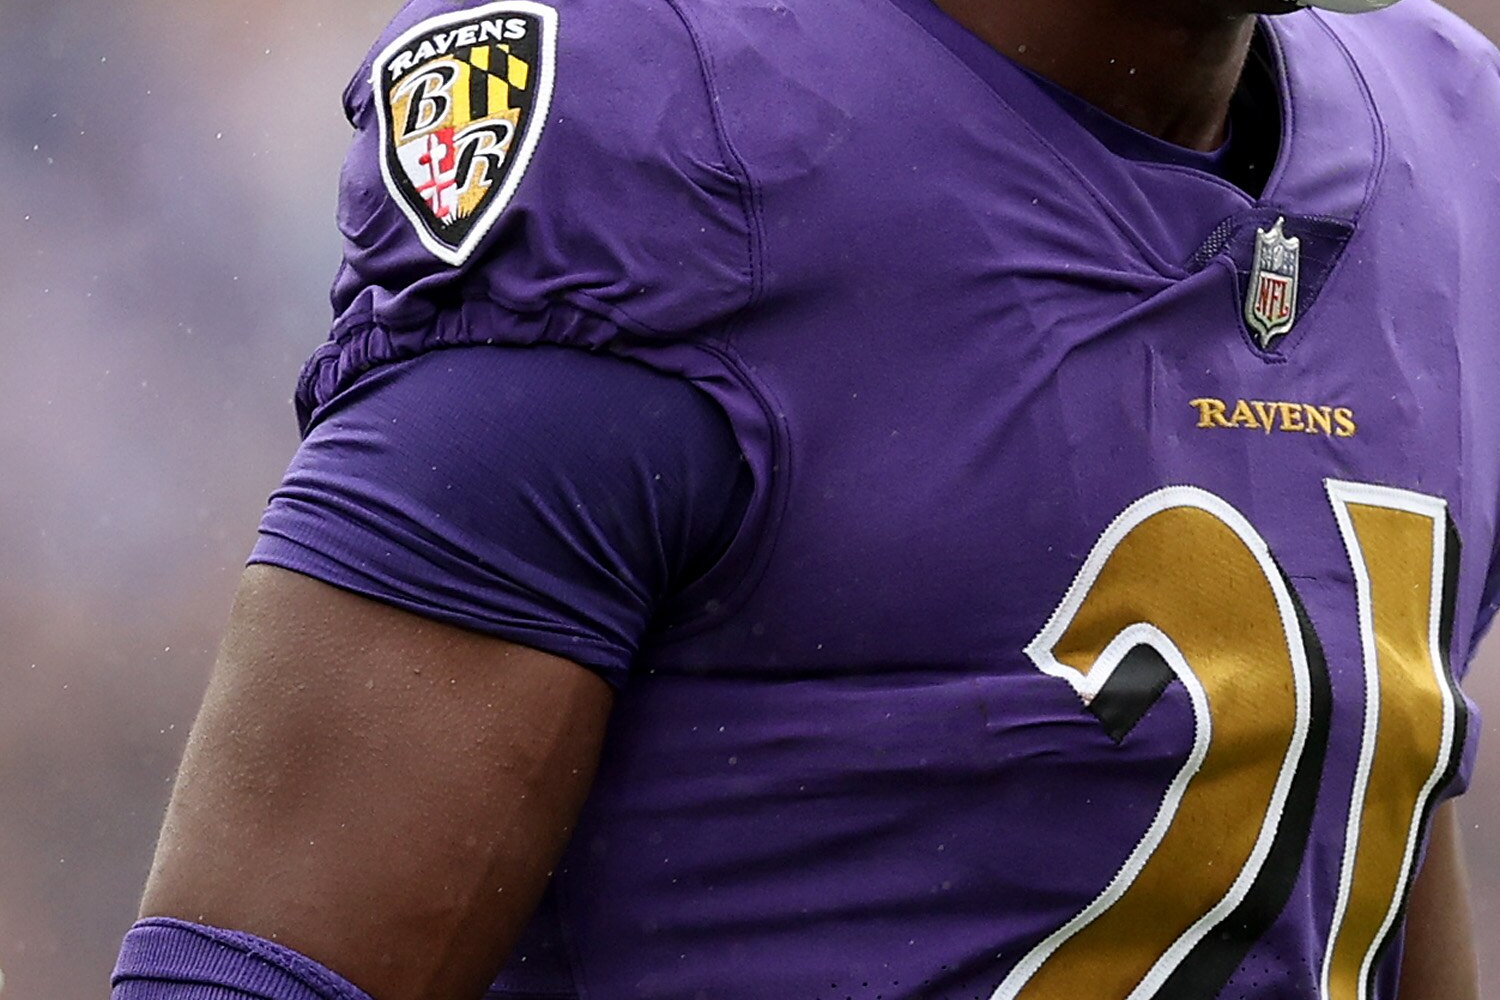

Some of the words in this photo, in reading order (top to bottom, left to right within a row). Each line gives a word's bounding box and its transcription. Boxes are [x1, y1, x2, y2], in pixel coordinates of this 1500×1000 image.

[387, 18, 528, 82] RAVENS
[1256, 275, 1290, 321] NFL
[1189, 397, 1358, 438] RAVENS
[989, 477, 1463, 1000] 21
